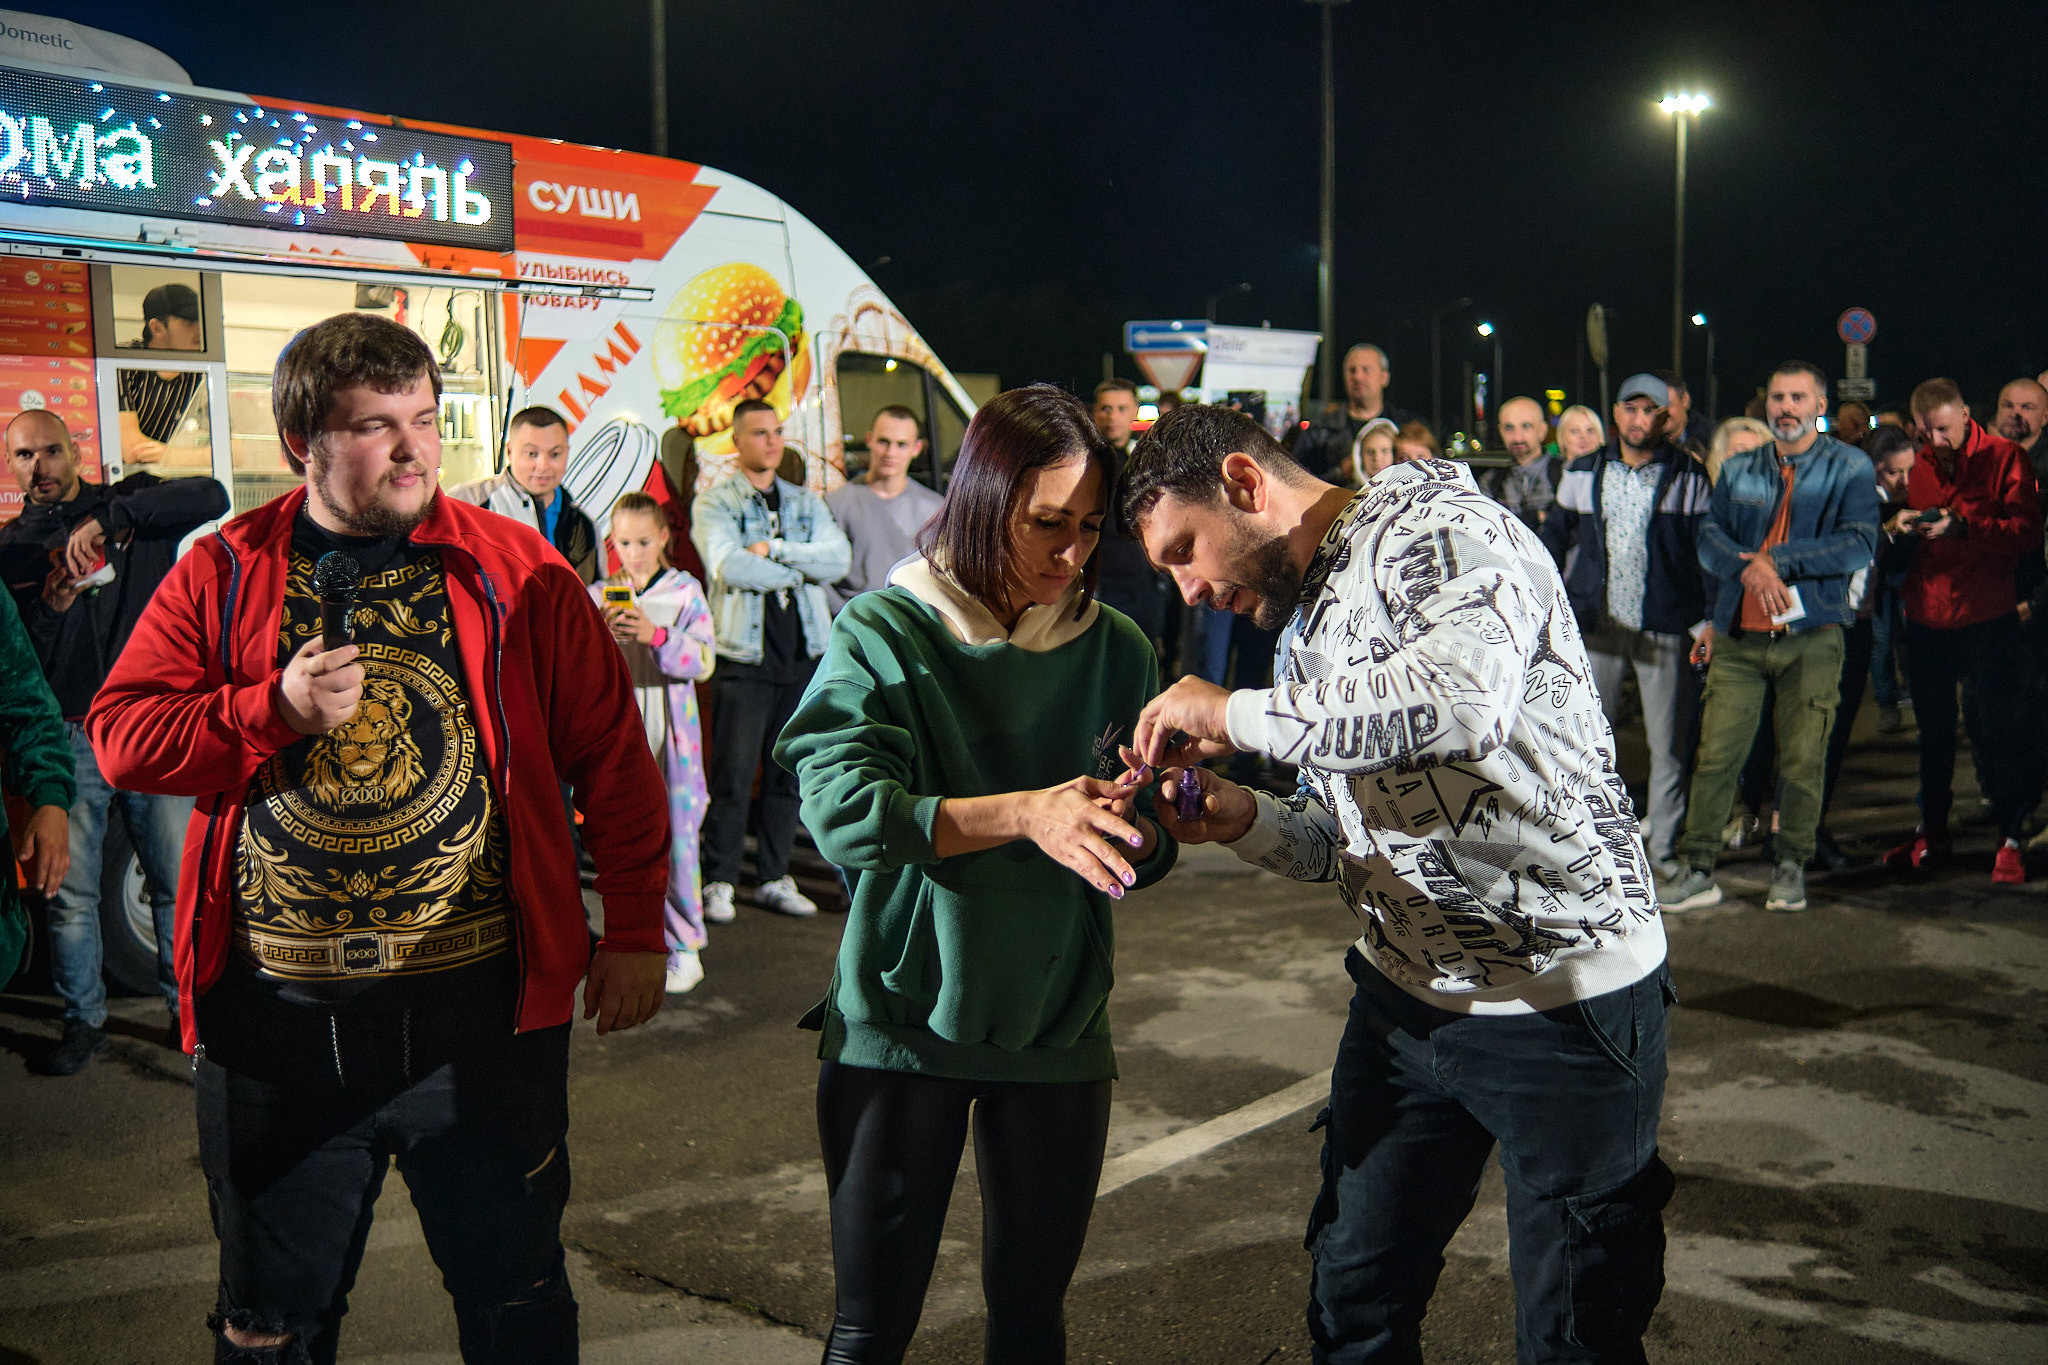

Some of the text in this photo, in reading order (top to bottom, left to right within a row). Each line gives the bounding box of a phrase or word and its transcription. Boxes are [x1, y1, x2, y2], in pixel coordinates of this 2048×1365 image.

[0, 22, 74, 50] ometic
[528, 180, 641, 222] СУШИ
[519, 261, 630, 285] УЛЫБНИСЬ
[1314, 703, 1438, 760] JUMP
[1537, 895, 1558, 916] AIR
